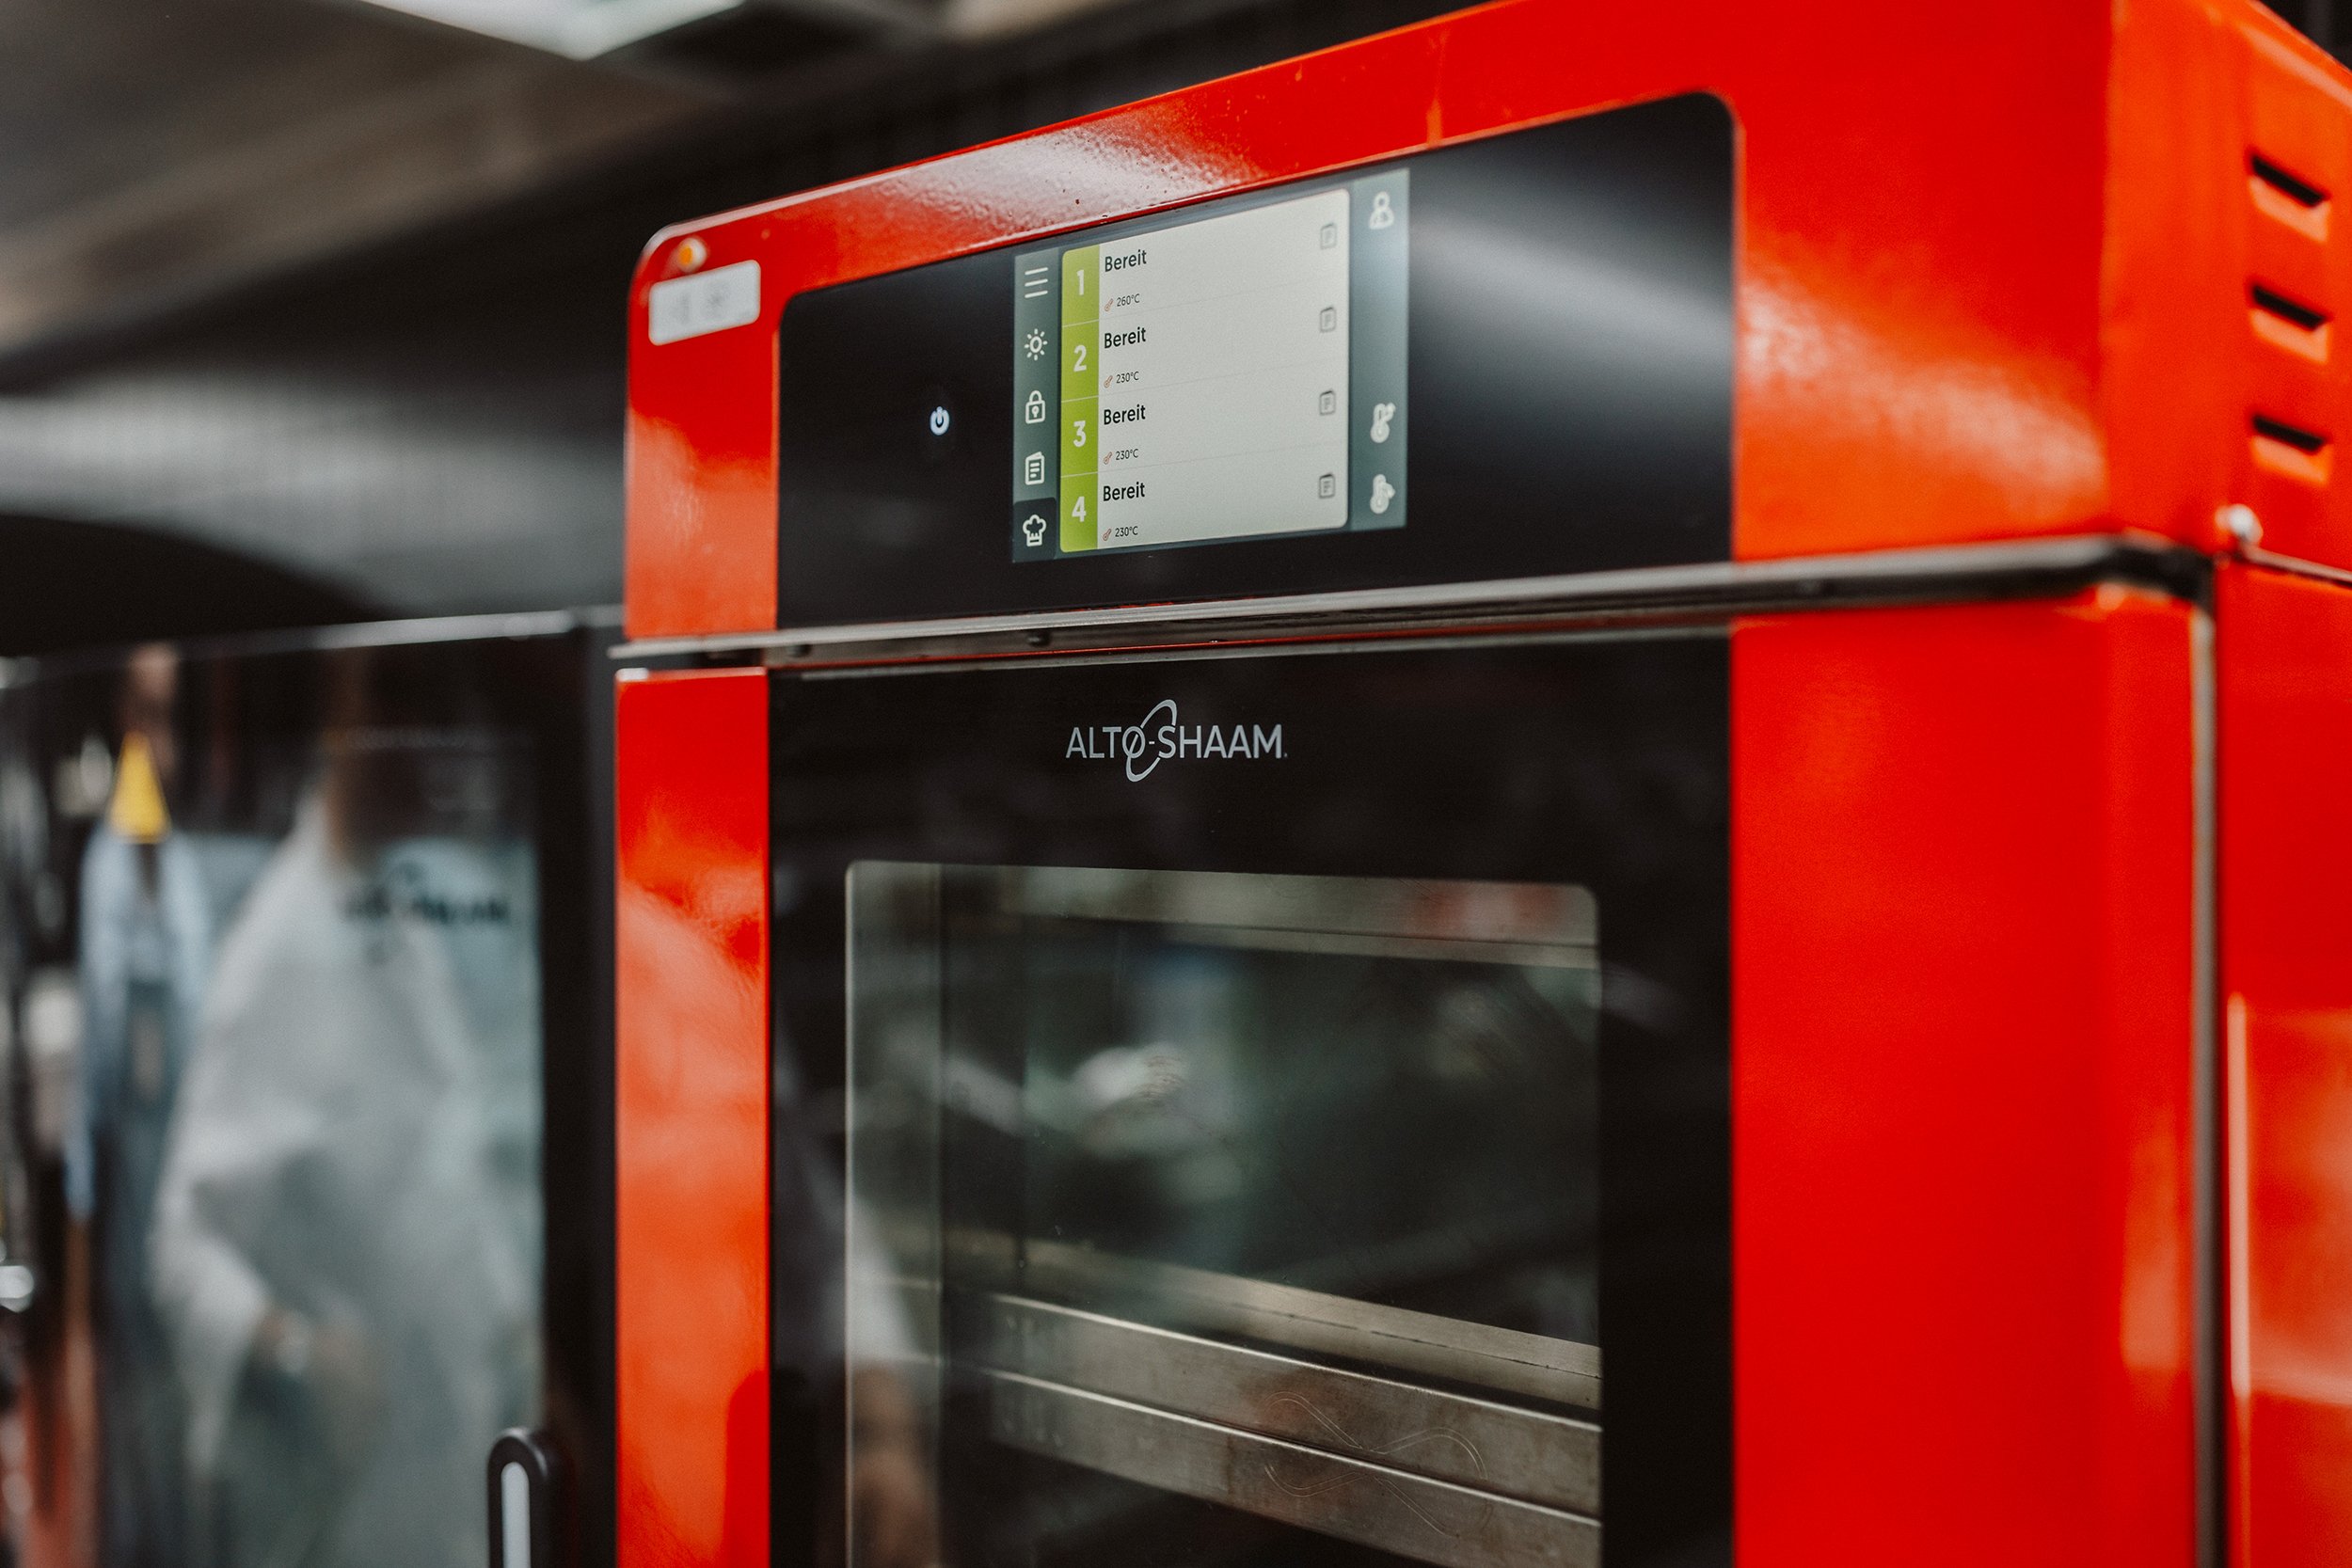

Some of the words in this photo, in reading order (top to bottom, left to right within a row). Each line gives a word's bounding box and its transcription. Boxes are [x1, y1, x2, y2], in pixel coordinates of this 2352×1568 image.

[1076, 269, 1085, 295] 1
[1104, 248, 1147, 273] Bereit
[1116, 293, 1140, 308] 260°C
[1073, 344, 1087, 372] 2
[1104, 326, 1147, 349] Bereit
[1115, 371, 1139, 384] 230°C
[1073, 420, 1087, 448] 3
[1104, 404, 1146, 425] Bereit
[1115, 448, 1138, 461] 230°C
[1072, 496, 1087, 523] 4
[1103, 481, 1145, 502] Bereit
[1114, 525, 1138, 538] 230°C
